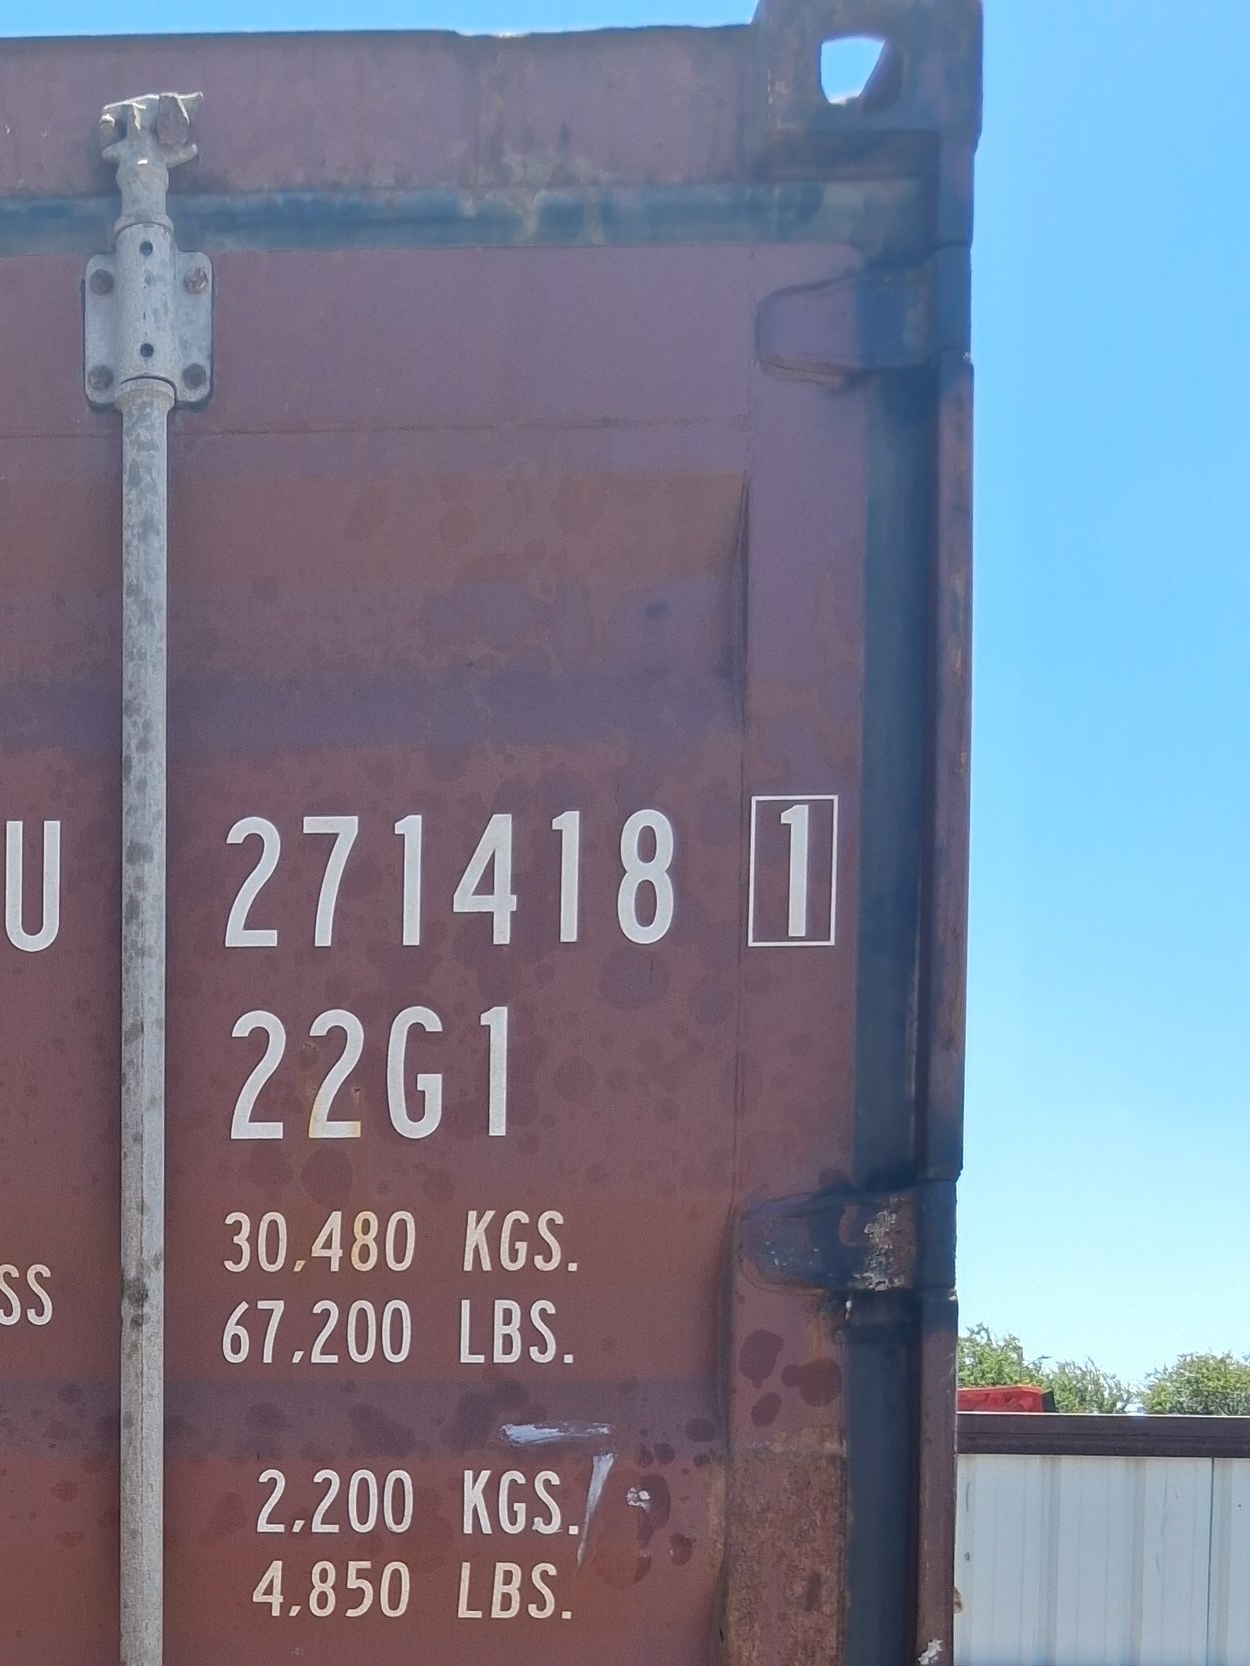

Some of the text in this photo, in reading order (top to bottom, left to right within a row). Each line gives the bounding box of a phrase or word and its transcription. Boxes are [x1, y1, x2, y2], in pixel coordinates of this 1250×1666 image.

[224, 808, 675, 948] 271418
[779, 804, 809, 937] 1
[230, 1005, 509, 1140] 22G1
[223, 1209, 578, 1273] 30,480 KGS.
[222, 1299, 574, 1364] 67,200 LBS.
[256, 1468, 579, 1535] 2,200 KGS.
[252, 1560, 572, 1620] 4,850 LBS.
